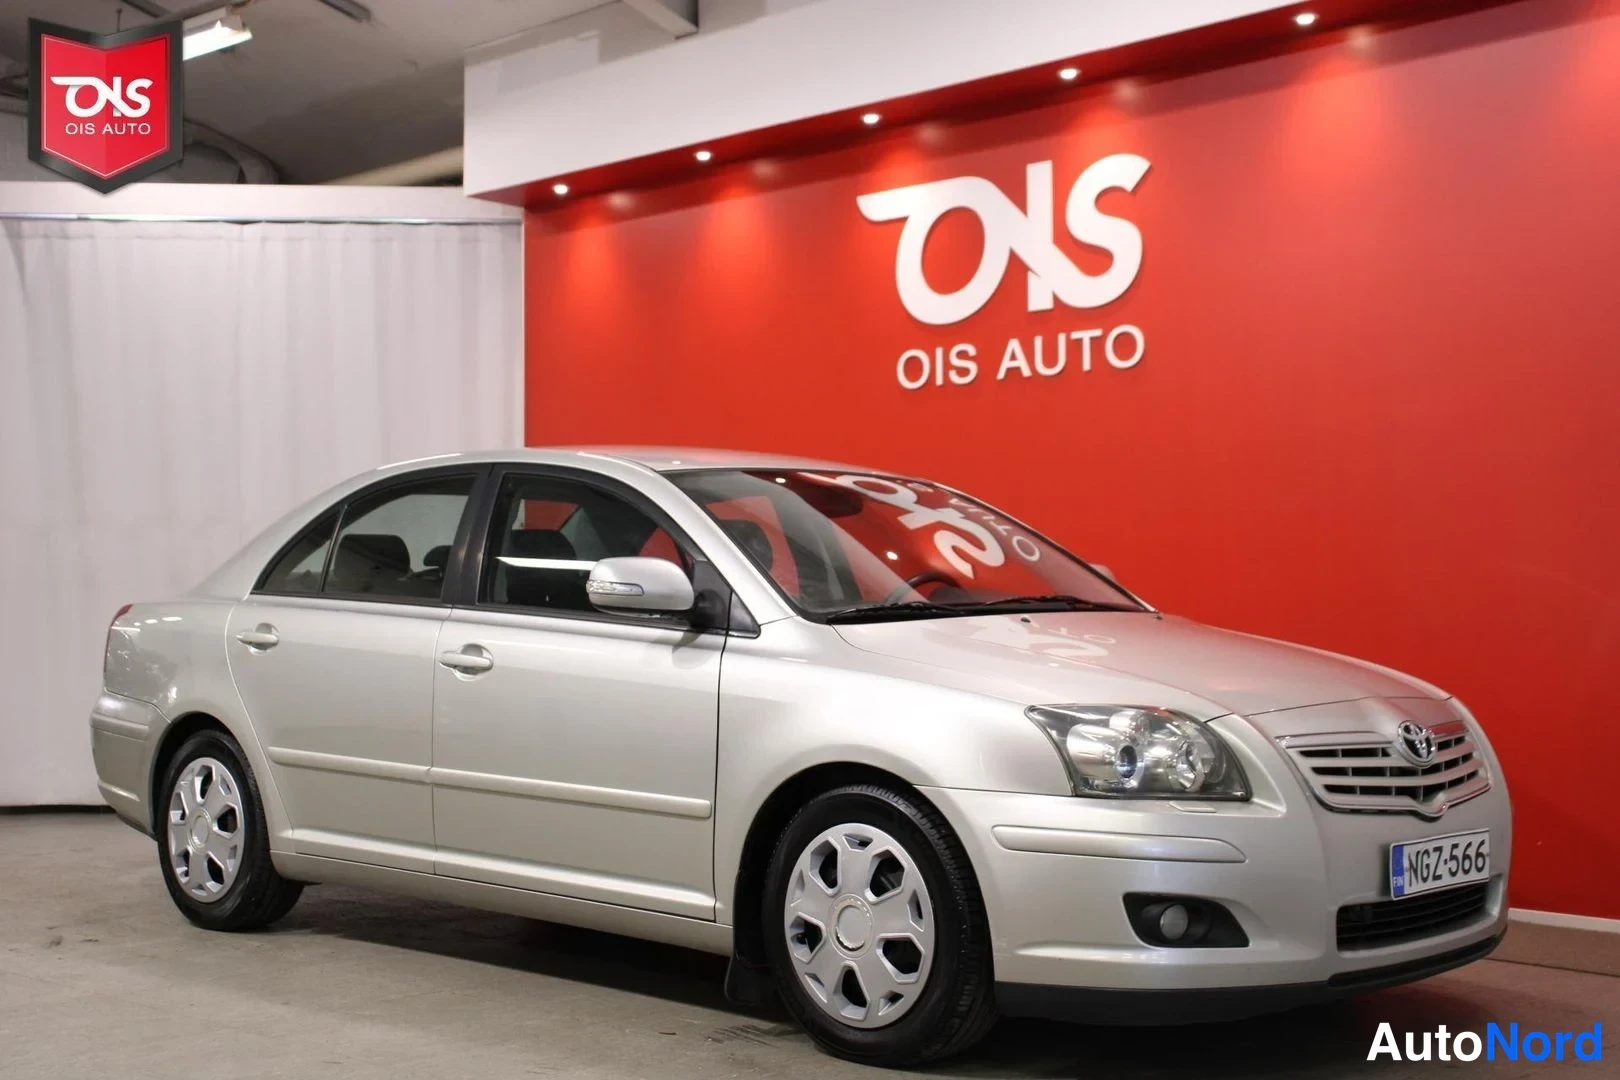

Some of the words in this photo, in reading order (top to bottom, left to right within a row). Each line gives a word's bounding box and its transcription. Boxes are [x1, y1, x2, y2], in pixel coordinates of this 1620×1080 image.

[856, 153, 1151, 325] OIS
[896, 343, 979, 390] OIS
[996, 324, 1145, 381] AUTO
[1408, 839, 1486, 887] NGZ-566
